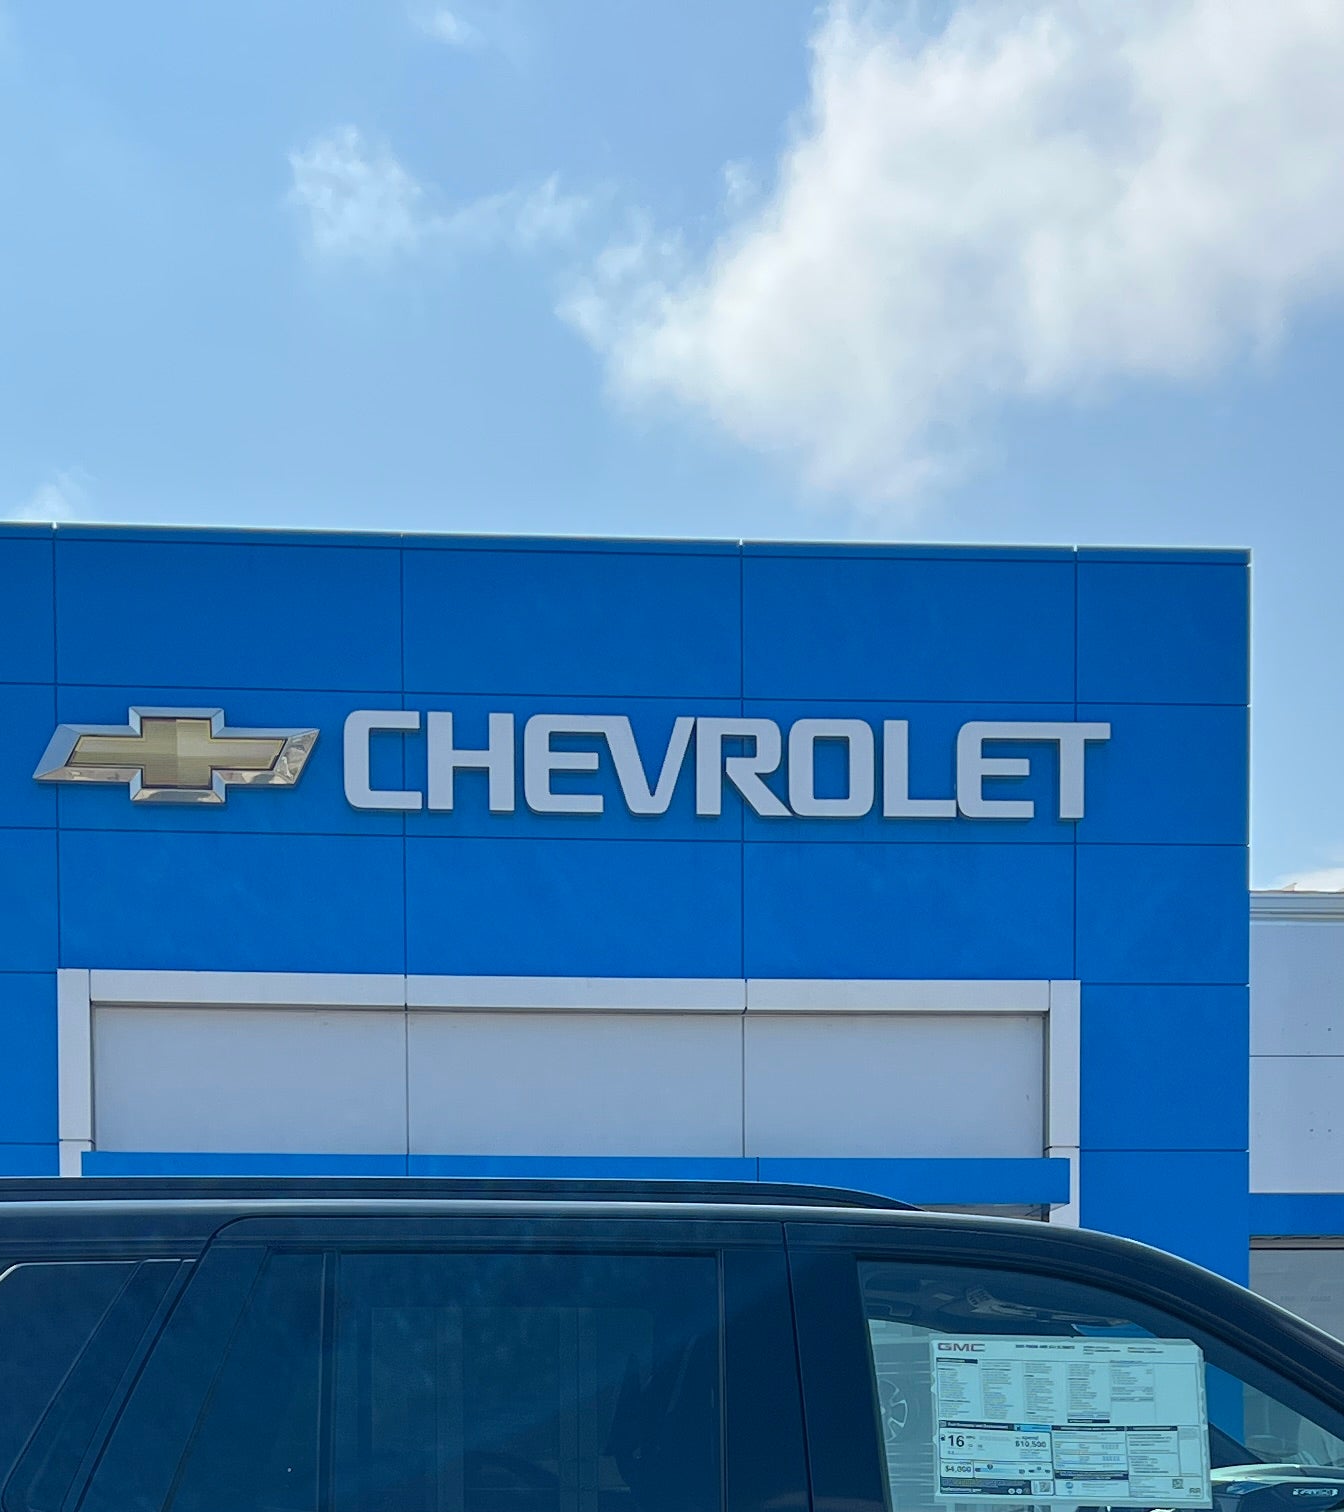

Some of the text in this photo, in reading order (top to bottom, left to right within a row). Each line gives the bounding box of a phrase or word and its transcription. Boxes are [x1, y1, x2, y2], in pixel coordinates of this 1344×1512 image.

[344, 709, 1112, 822] CHEVROLET
[938, 1342, 986, 1352] GMC
[948, 1434, 965, 1447] 16
